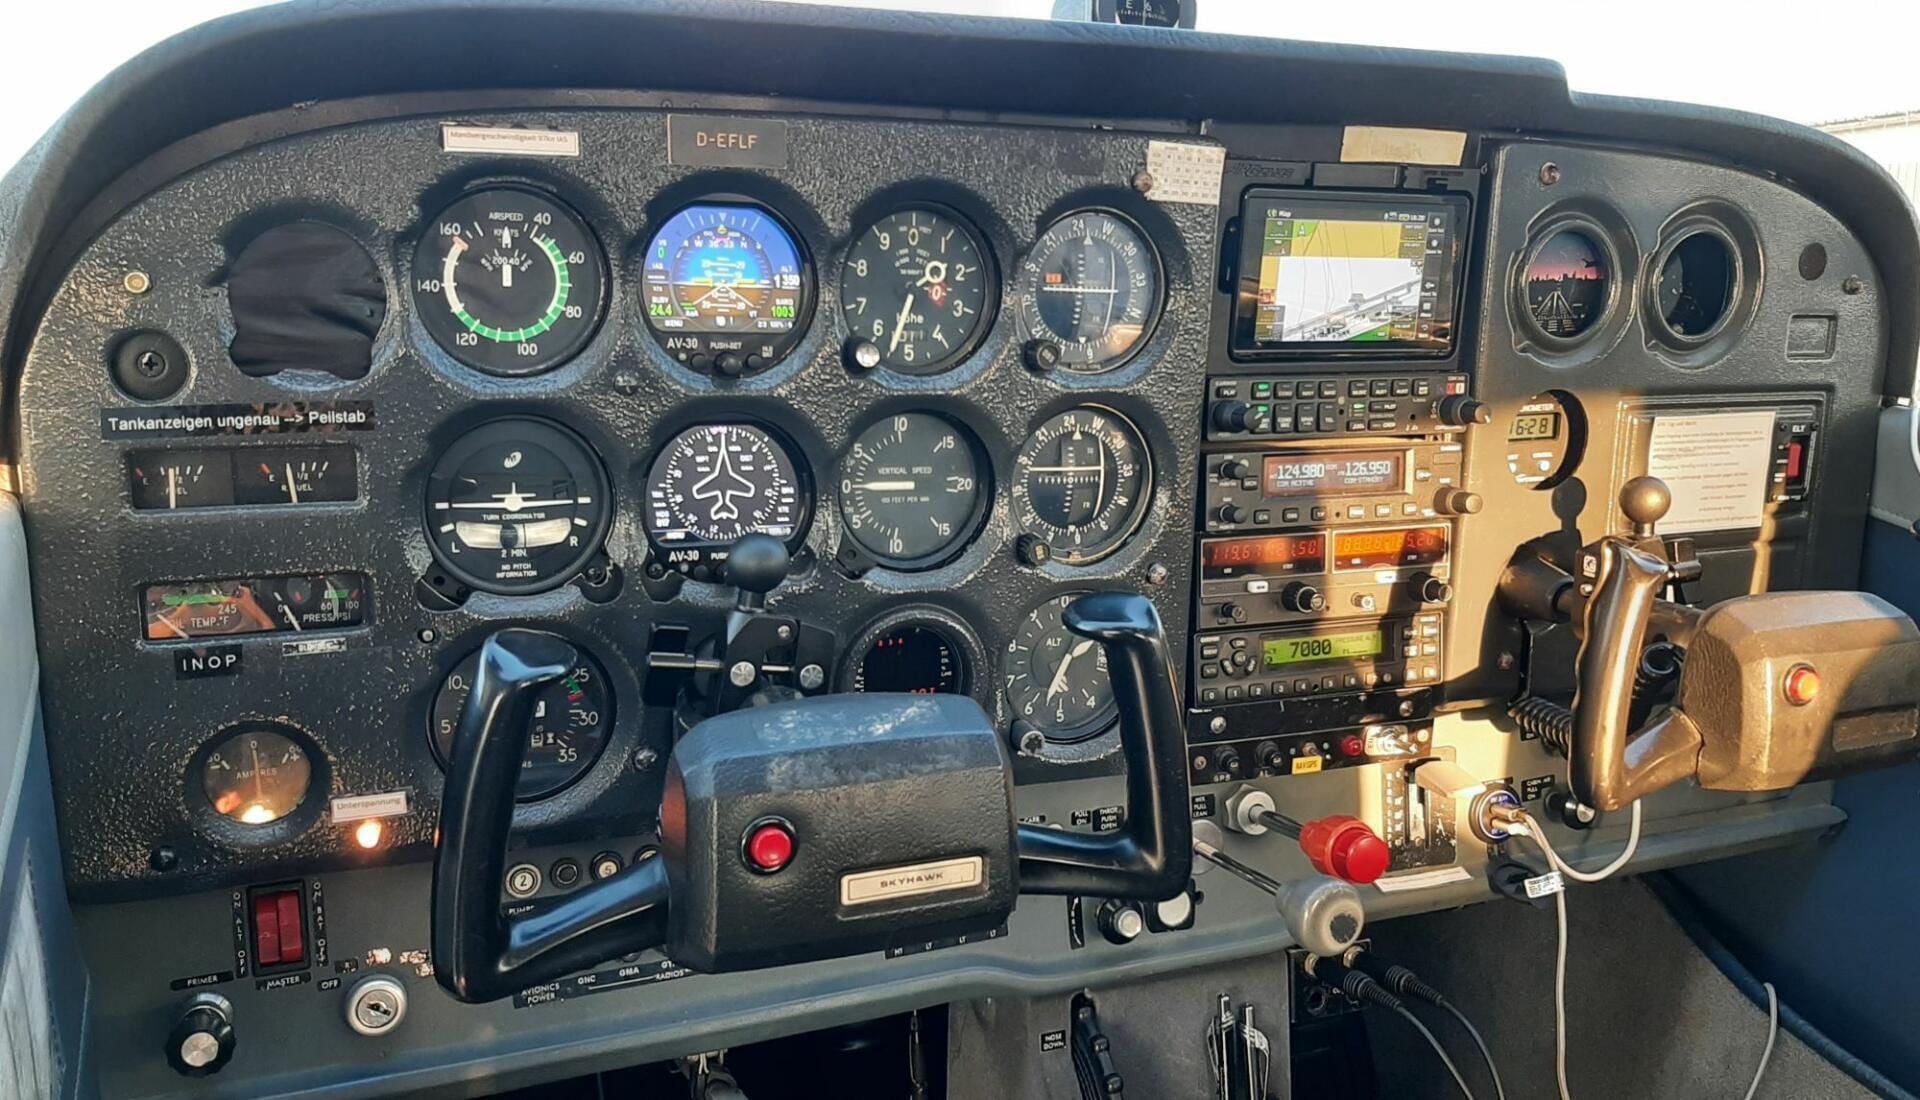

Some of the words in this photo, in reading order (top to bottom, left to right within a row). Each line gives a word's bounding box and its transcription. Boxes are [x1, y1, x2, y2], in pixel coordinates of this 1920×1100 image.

[696, 132, 758, 148] D-EFLF
[488, 212, 524, 220] AIRSPEED
[533, 213, 551, 224] 40
[440, 222, 461, 235] 160
[1072, 219, 1084, 230] 24
[1102, 220, 1115, 236] W
[880, 232, 890, 250] 9
[908, 228, 918, 246] 0
[1124, 242, 1136, 256] 30
[568, 252, 584, 264] 60
[856, 259, 868, 277] 8
[955, 264, 966, 282] 2
[417, 280, 440, 292] 140
[1136, 272, 1146, 288] 33
[566, 306, 582, 318] 80
[650, 304, 672, 316] 24.4
[770, 306, 795, 318] 1003
[856, 298, 867, 315] 7
[952, 300, 964, 317] 3
[872, 320, 884, 336] 6
[932, 324, 942, 338] 4
[456, 333, 478, 346] 120
[666, 338, 698, 349] AV-30
[518, 344, 538, 356] 100
[904, 344, 914, 362] 5
[108, 416, 212, 432] Tankanzeigen
[216, 416, 280, 430] ungenau
[308, 410, 366, 424] Peilstab
[894, 417, 908, 432] 10
[1064, 415, 1075, 427] 24
[1092, 416, 1104, 430] W
[1036, 428, 1048, 440] 21
[1792, 424, 1806, 432] ELT
[942, 436, 954, 448] 15
[1113, 436, 1126, 449] 30
[854, 444, 863, 458] 5
[1122, 463, 1133, 477] 33
[1277, 464, 1324, 480] 124.980
[1345, 460, 1391, 476] 126.950
[269, 474, 275, 482] E
[318, 472, 324, 480] F
[842, 480, 852, 494] 0
[957, 478, 972, 490] 20
[1117, 496, 1129, 506] N
[852, 514, 862, 528] 5
[938, 523, 950, 536] 15
[570, 536, 578, 546] R
[889, 540, 902, 553] 10
[452, 542, 460, 553] L
[501, 550, 506, 558] 2
[668, 550, 700, 562] AV-30
[496, 570, 537, 578] INFORMATION
[320, 602, 332, 610] 60
[1061, 596, 1068, 608] 0
[218, 604, 237, 615] 245
[1046, 638, 1062, 647] ALT
[1289, 640, 1332, 658] 7000
[182, 654, 236, 671] INOP
[574, 668, 590, 682] 25
[448, 676, 463, 690] 10
[1007, 676, 1015, 688] 7
[1278, 684, 1284, 692] 3
[1256, 687, 1262, 695] 2
[1024, 702, 1033, 715] 6
[1086, 696, 1096, 709] 4
[578, 712, 598, 726] 30
[1056, 710, 1064, 722] 5
[441, 720, 451, 734] 5
[250, 740, 257, 748] 0
[558, 748, 578, 763] 35
[236, 768, 277, 780] AMPRES
[336, 798, 401, 810] Unterspannung
[1101, 823, 1118, 831] OPEN
[604, 864, 612, 874] 5
[520, 875, 527, 886] 2
[880, 872, 944, 888] SKYHAWK
[618, 968, 640, 977] GMA
[656, 970, 684, 980] RADIOS
[187, 976, 218, 986] PRIMER
[266, 976, 300, 990] MASTER
[321, 978, 338, 989] OFF
[578, 975, 596, 984] GNC
[520, 983, 560, 996] AVIONICS
[528, 992, 556, 1004] POWER
[1044, 1033, 1062, 1042] NOSE
[1043, 1041, 1064, 1050] DOWN
